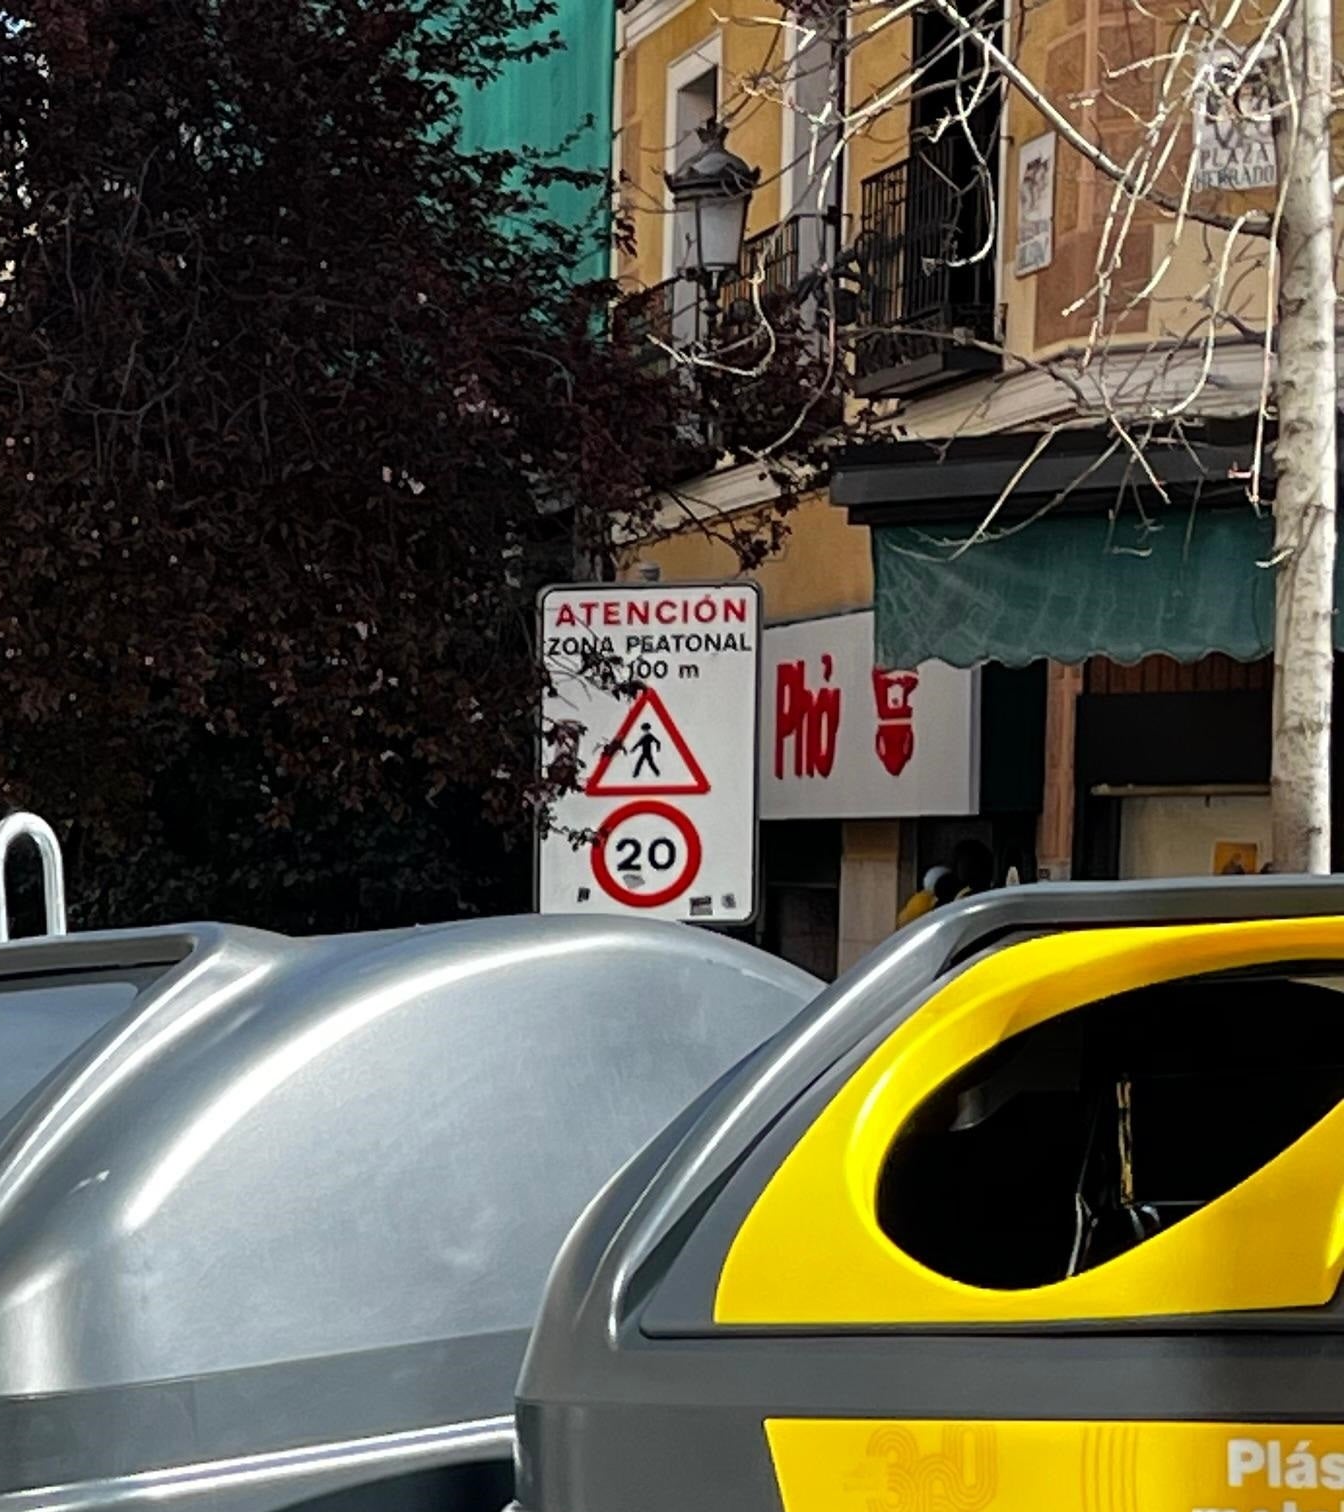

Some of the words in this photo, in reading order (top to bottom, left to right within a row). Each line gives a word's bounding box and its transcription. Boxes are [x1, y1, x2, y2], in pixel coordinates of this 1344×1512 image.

[555, 594, 747, 627] ATENCIÓN
[548, 635, 615, 656] ZONA
[626, 632, 753, 654] PEATONAL
[678, 664, 700, 679] m
[615, 836, 677, 871] 20
[1227, 1439, 1344, 1490] Plás
